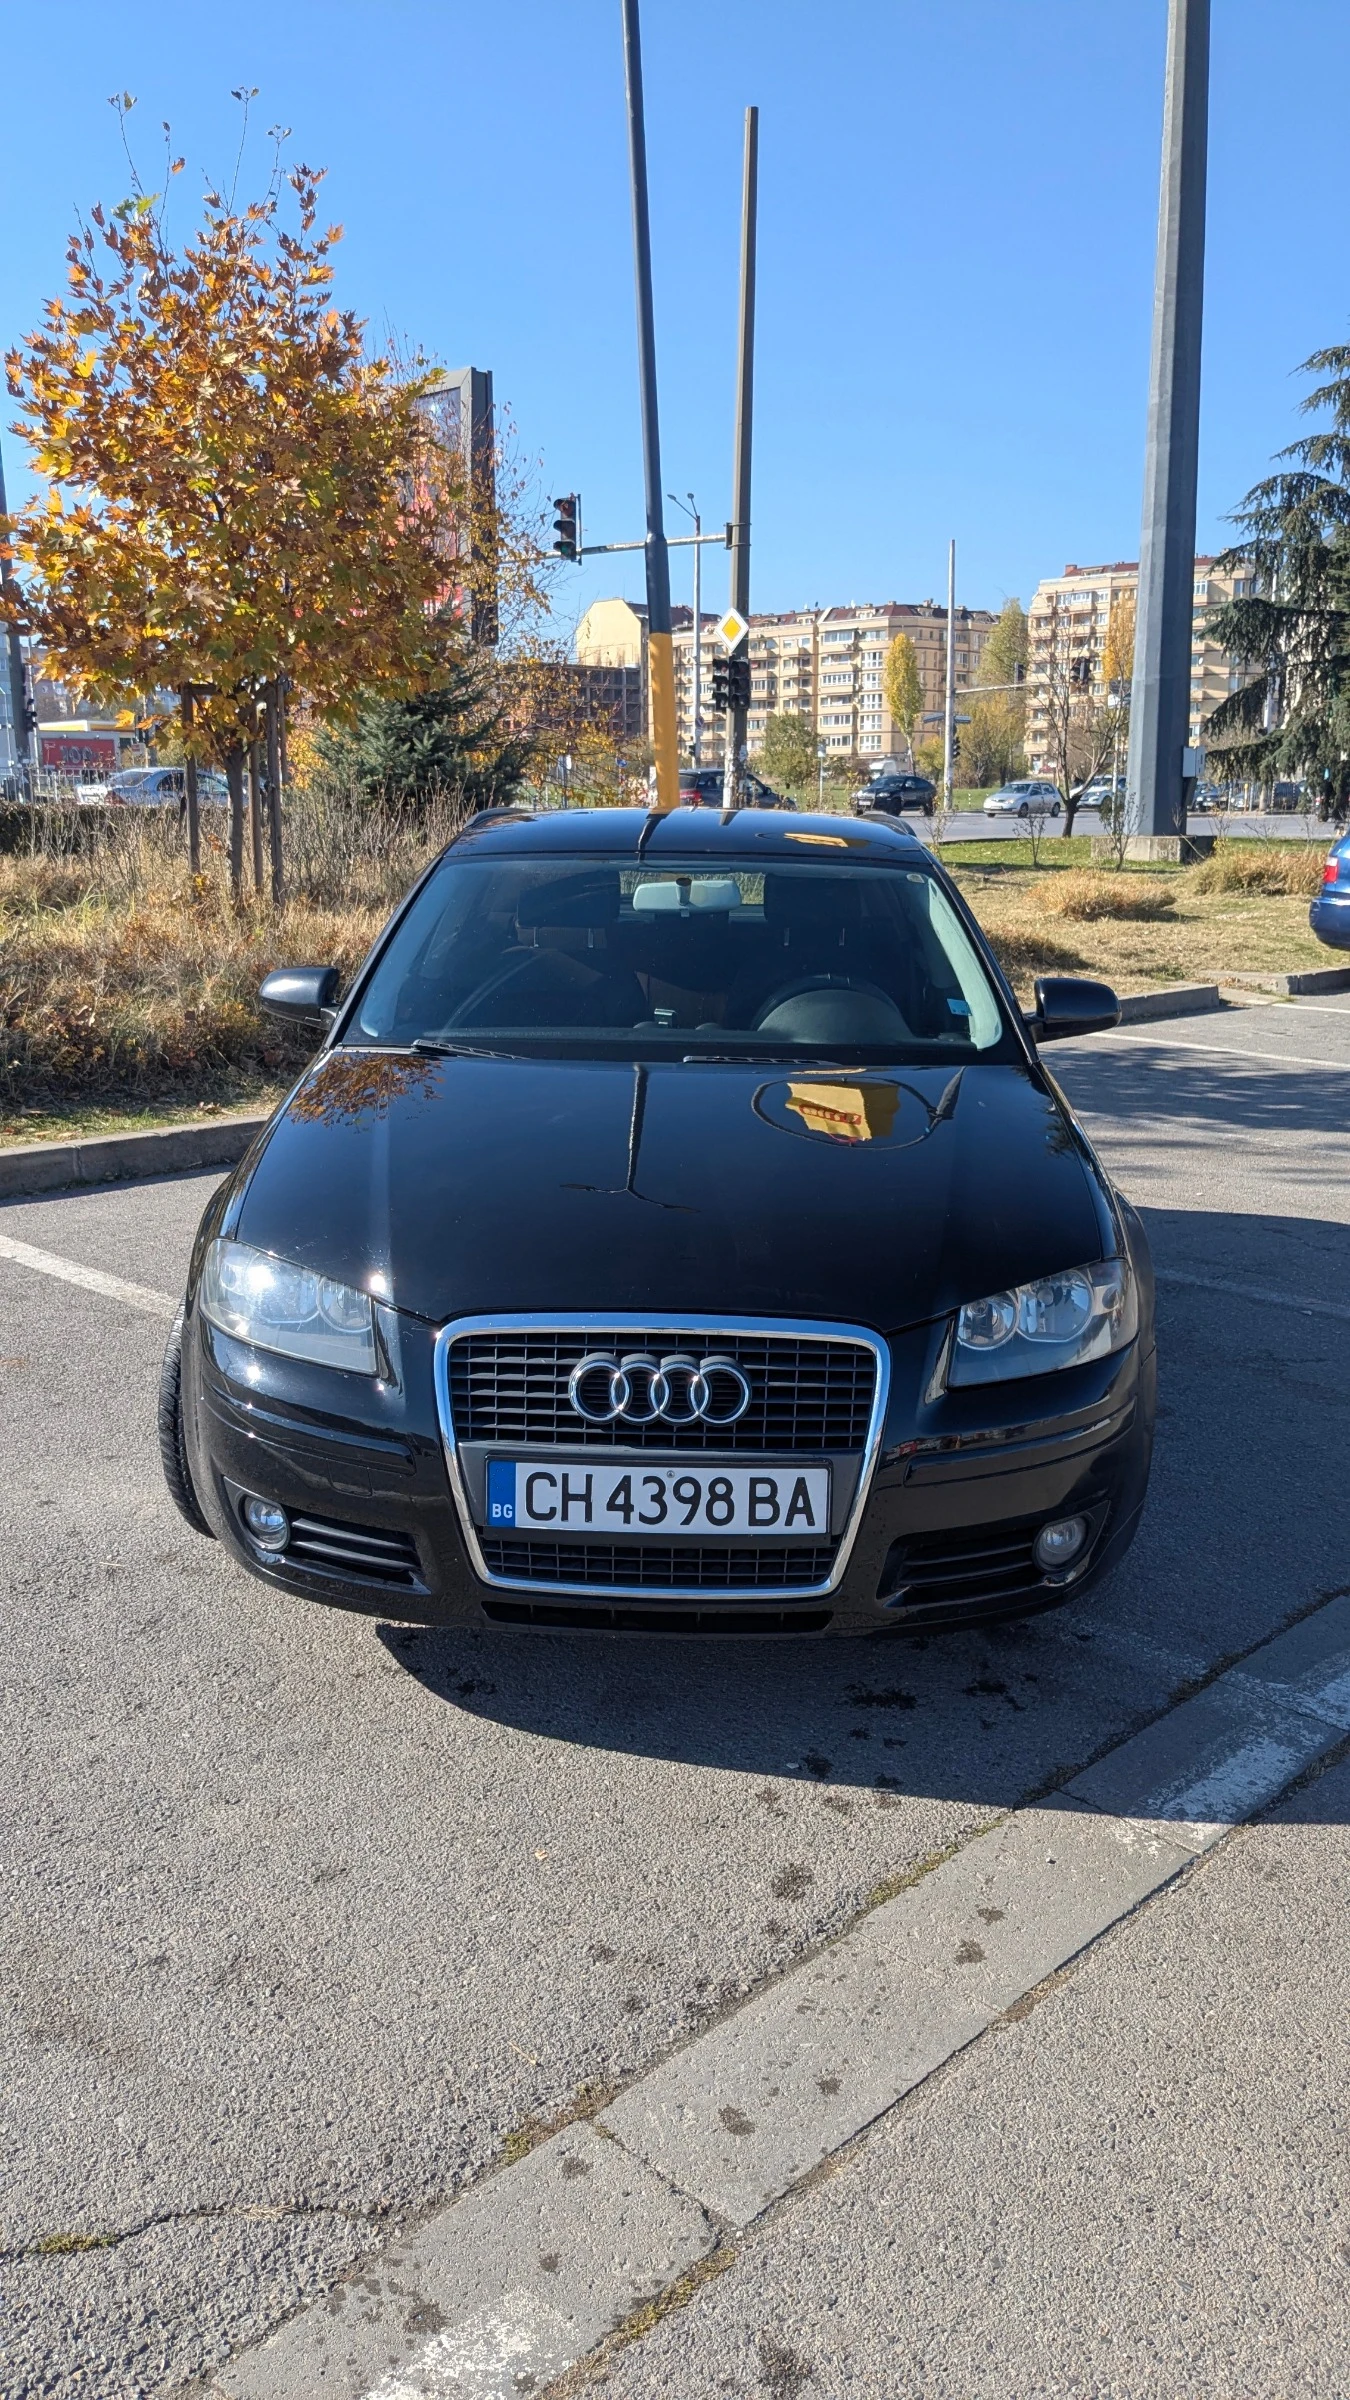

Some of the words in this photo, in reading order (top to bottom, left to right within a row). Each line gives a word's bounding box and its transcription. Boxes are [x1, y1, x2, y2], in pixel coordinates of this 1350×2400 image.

[492, 1503, 513, 1519] BG
[525, 1471, 593, 1523] CH
[606, 1474, 735, 1527] 4398
[748, 1476, 816, 1527] BA
